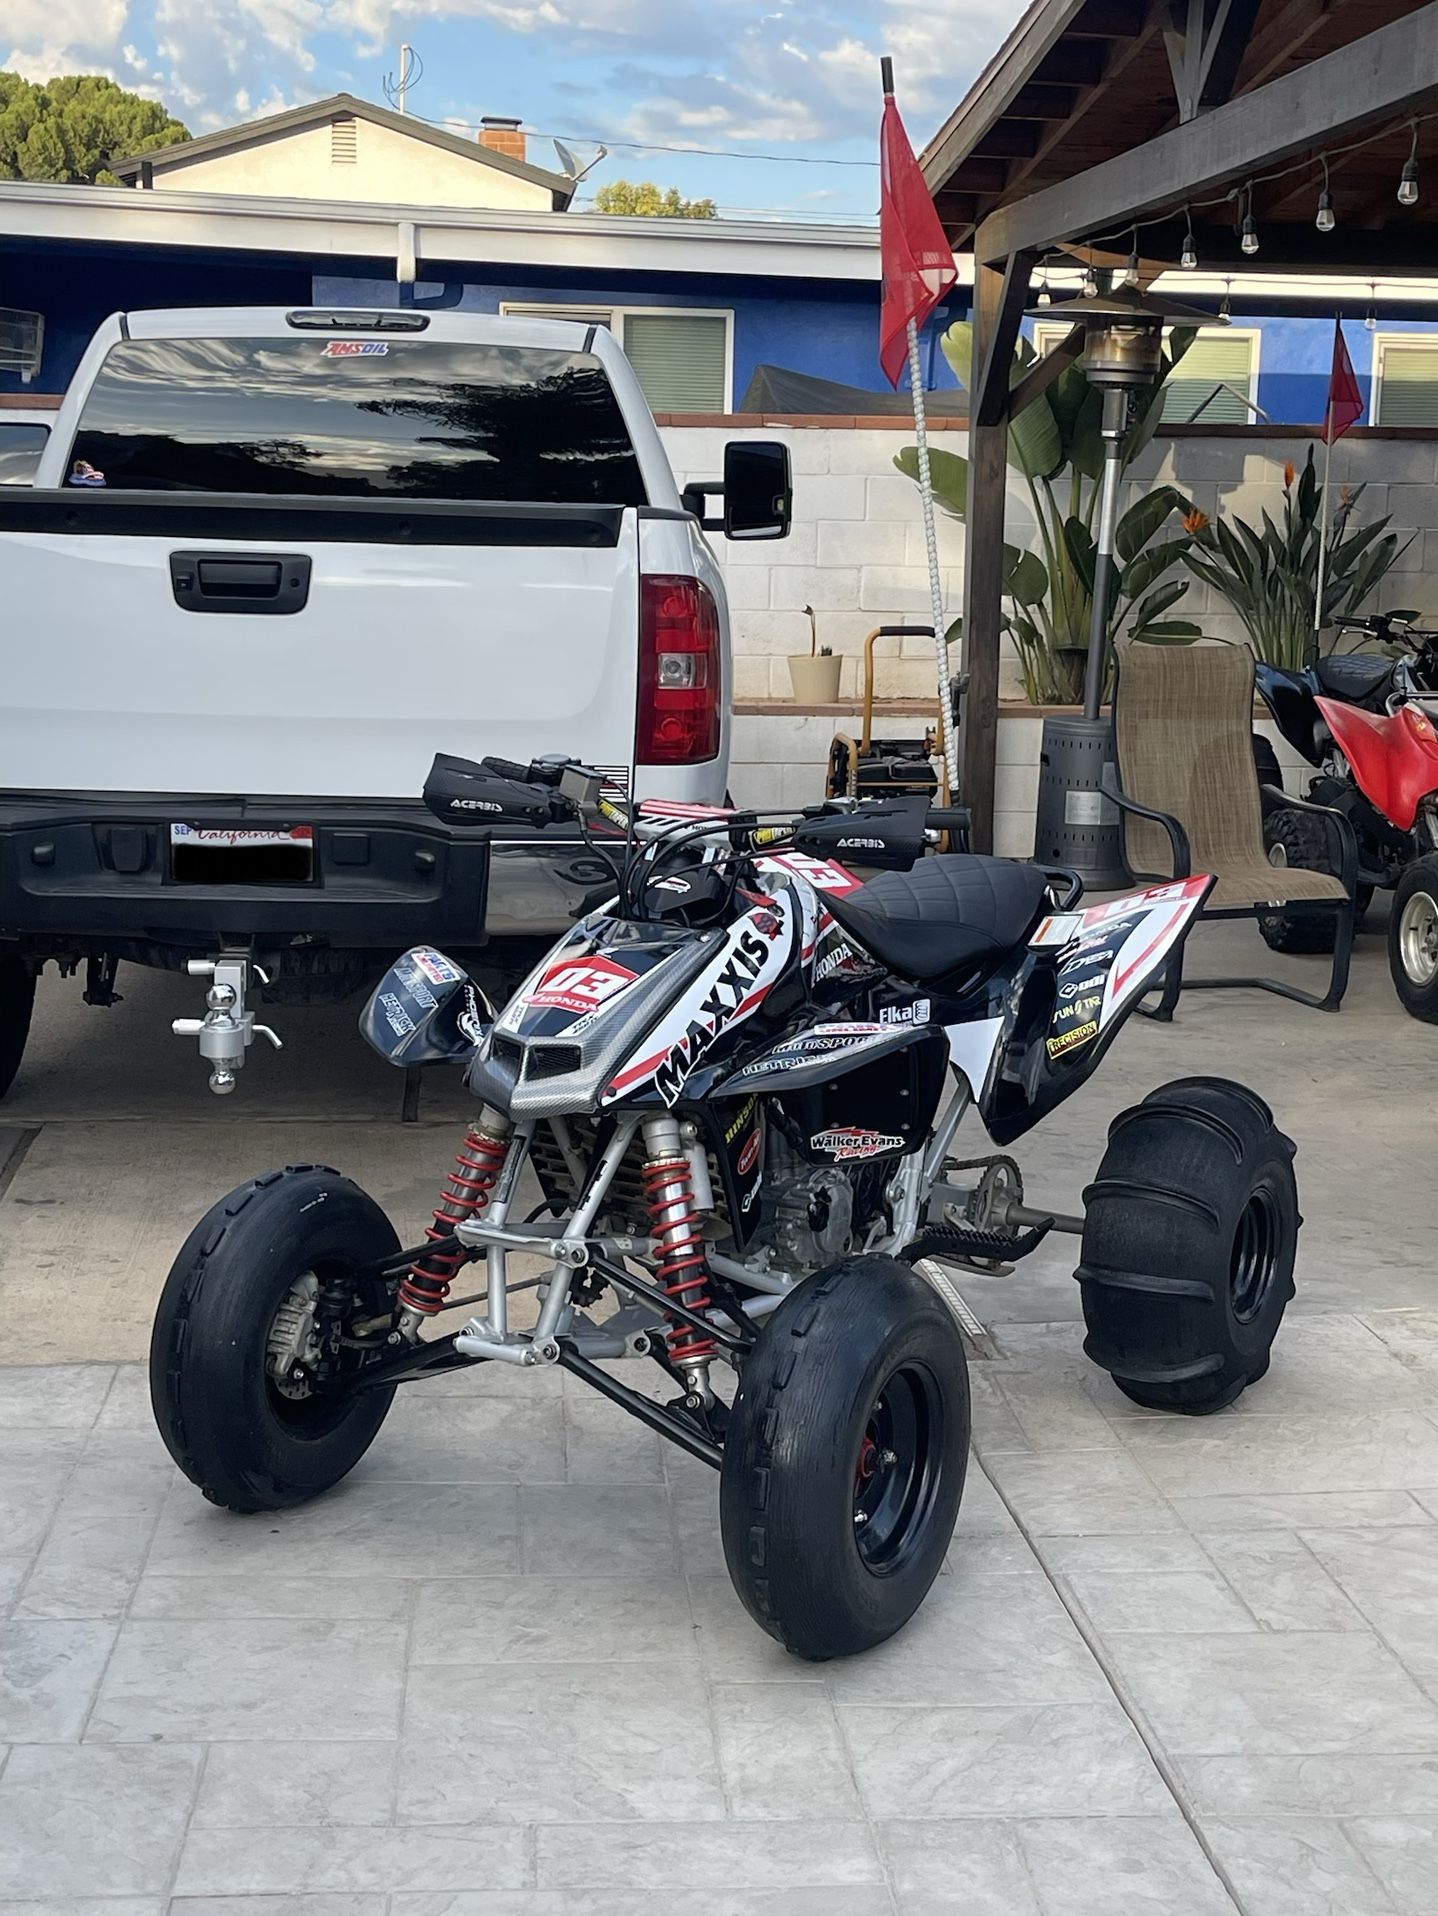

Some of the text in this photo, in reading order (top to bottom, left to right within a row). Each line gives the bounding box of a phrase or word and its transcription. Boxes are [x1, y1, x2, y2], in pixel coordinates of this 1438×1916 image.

[324, 342, 388, 356] AMSOIL
[450, 799, 503, 813] ACERBIS
[173, 825, 192, 836] SEP
[836, 838, 886, 849] ACERBIS
[815, 942, 853, 983] HONDA
[539, 966, 630, 1001] 03
[1078, 974, 1106, 992] ODI
[465, 984, 485, 1037] PHOENIX
[540, 995, 598, 1012] HONDA
[655, 930, 769, 1109] MAXXIS
[879, 1006, 913, 1024] Elka
[1047, 1022, 1097, 1054] PRECISION
[812, 1136, 903, 1149] Walker Evans
[835, 1145, 877, 1162] Racing
